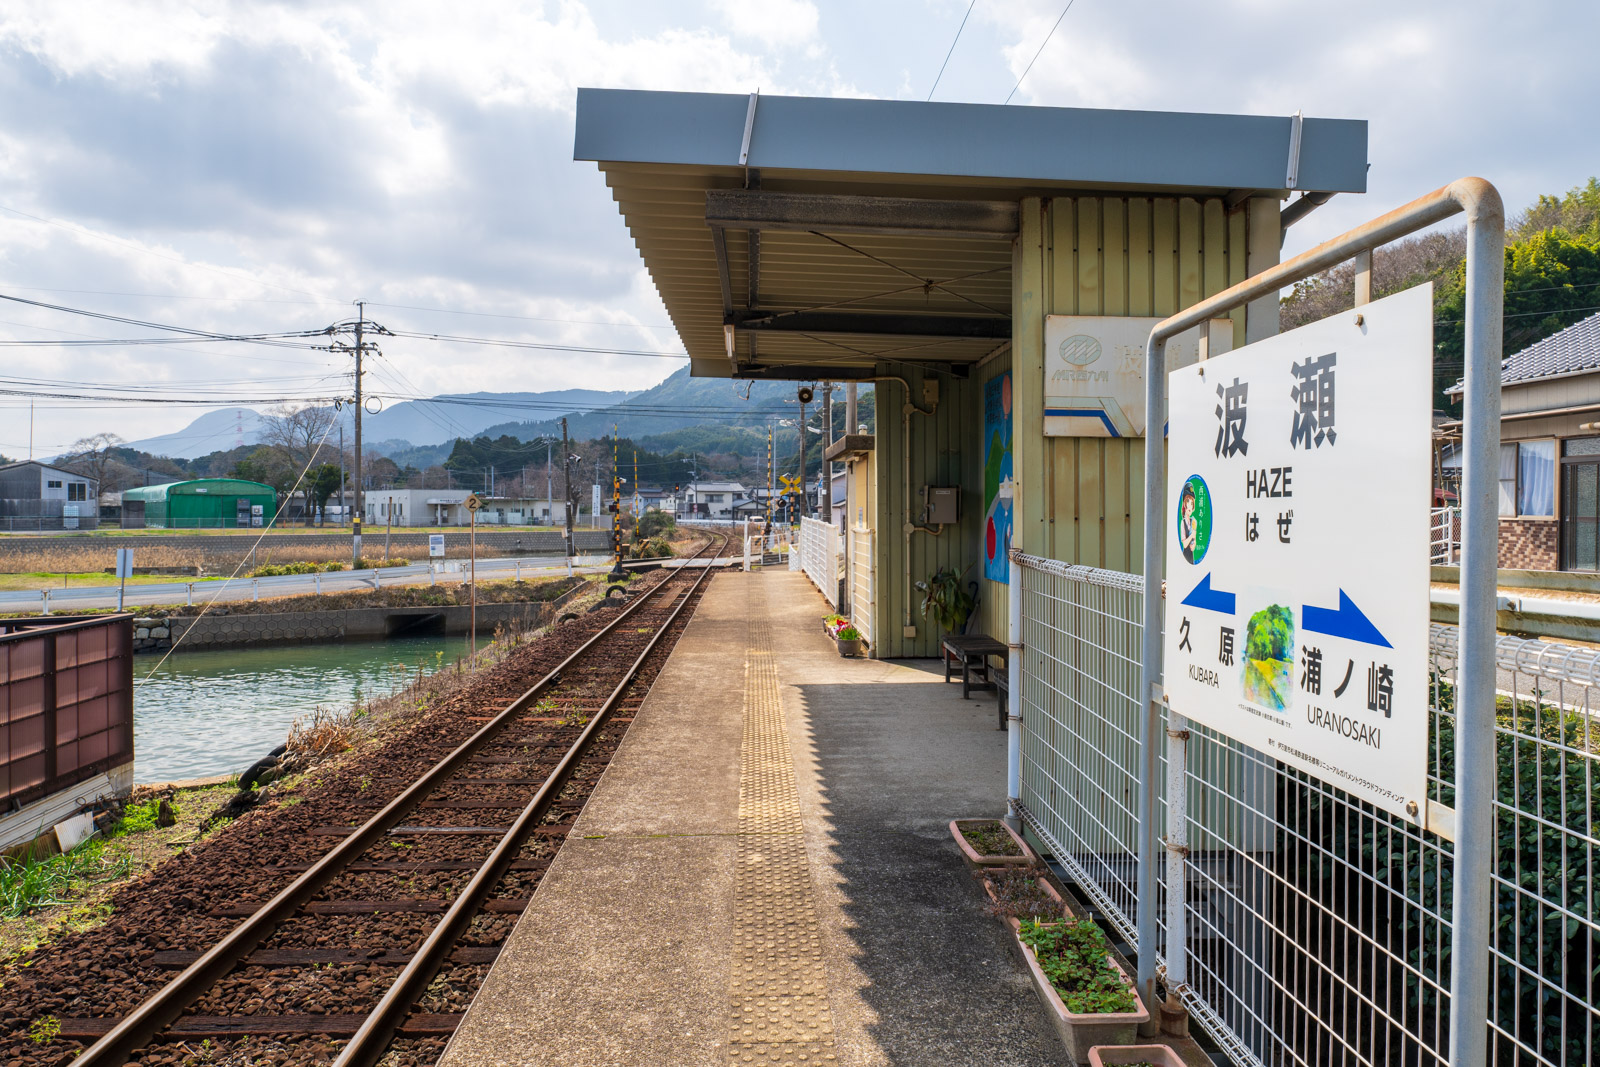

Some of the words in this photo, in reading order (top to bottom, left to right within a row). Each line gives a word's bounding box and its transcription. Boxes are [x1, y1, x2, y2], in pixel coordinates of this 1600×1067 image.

[1215, 352, 1337, 459] 波瀬
[1246, 467, 1292, 498] HAZE
[469, 498, 476, 509] 2
[1245, 509, 1293, 544] はぜ
[1178, 616, 1235, 667] 久原
[1188, 664, 1220, 688] KUBARA
[1300, 645, 1394, 718] 浦ノ崎
[1307, 704, 1381, 750] URANOSAKI
